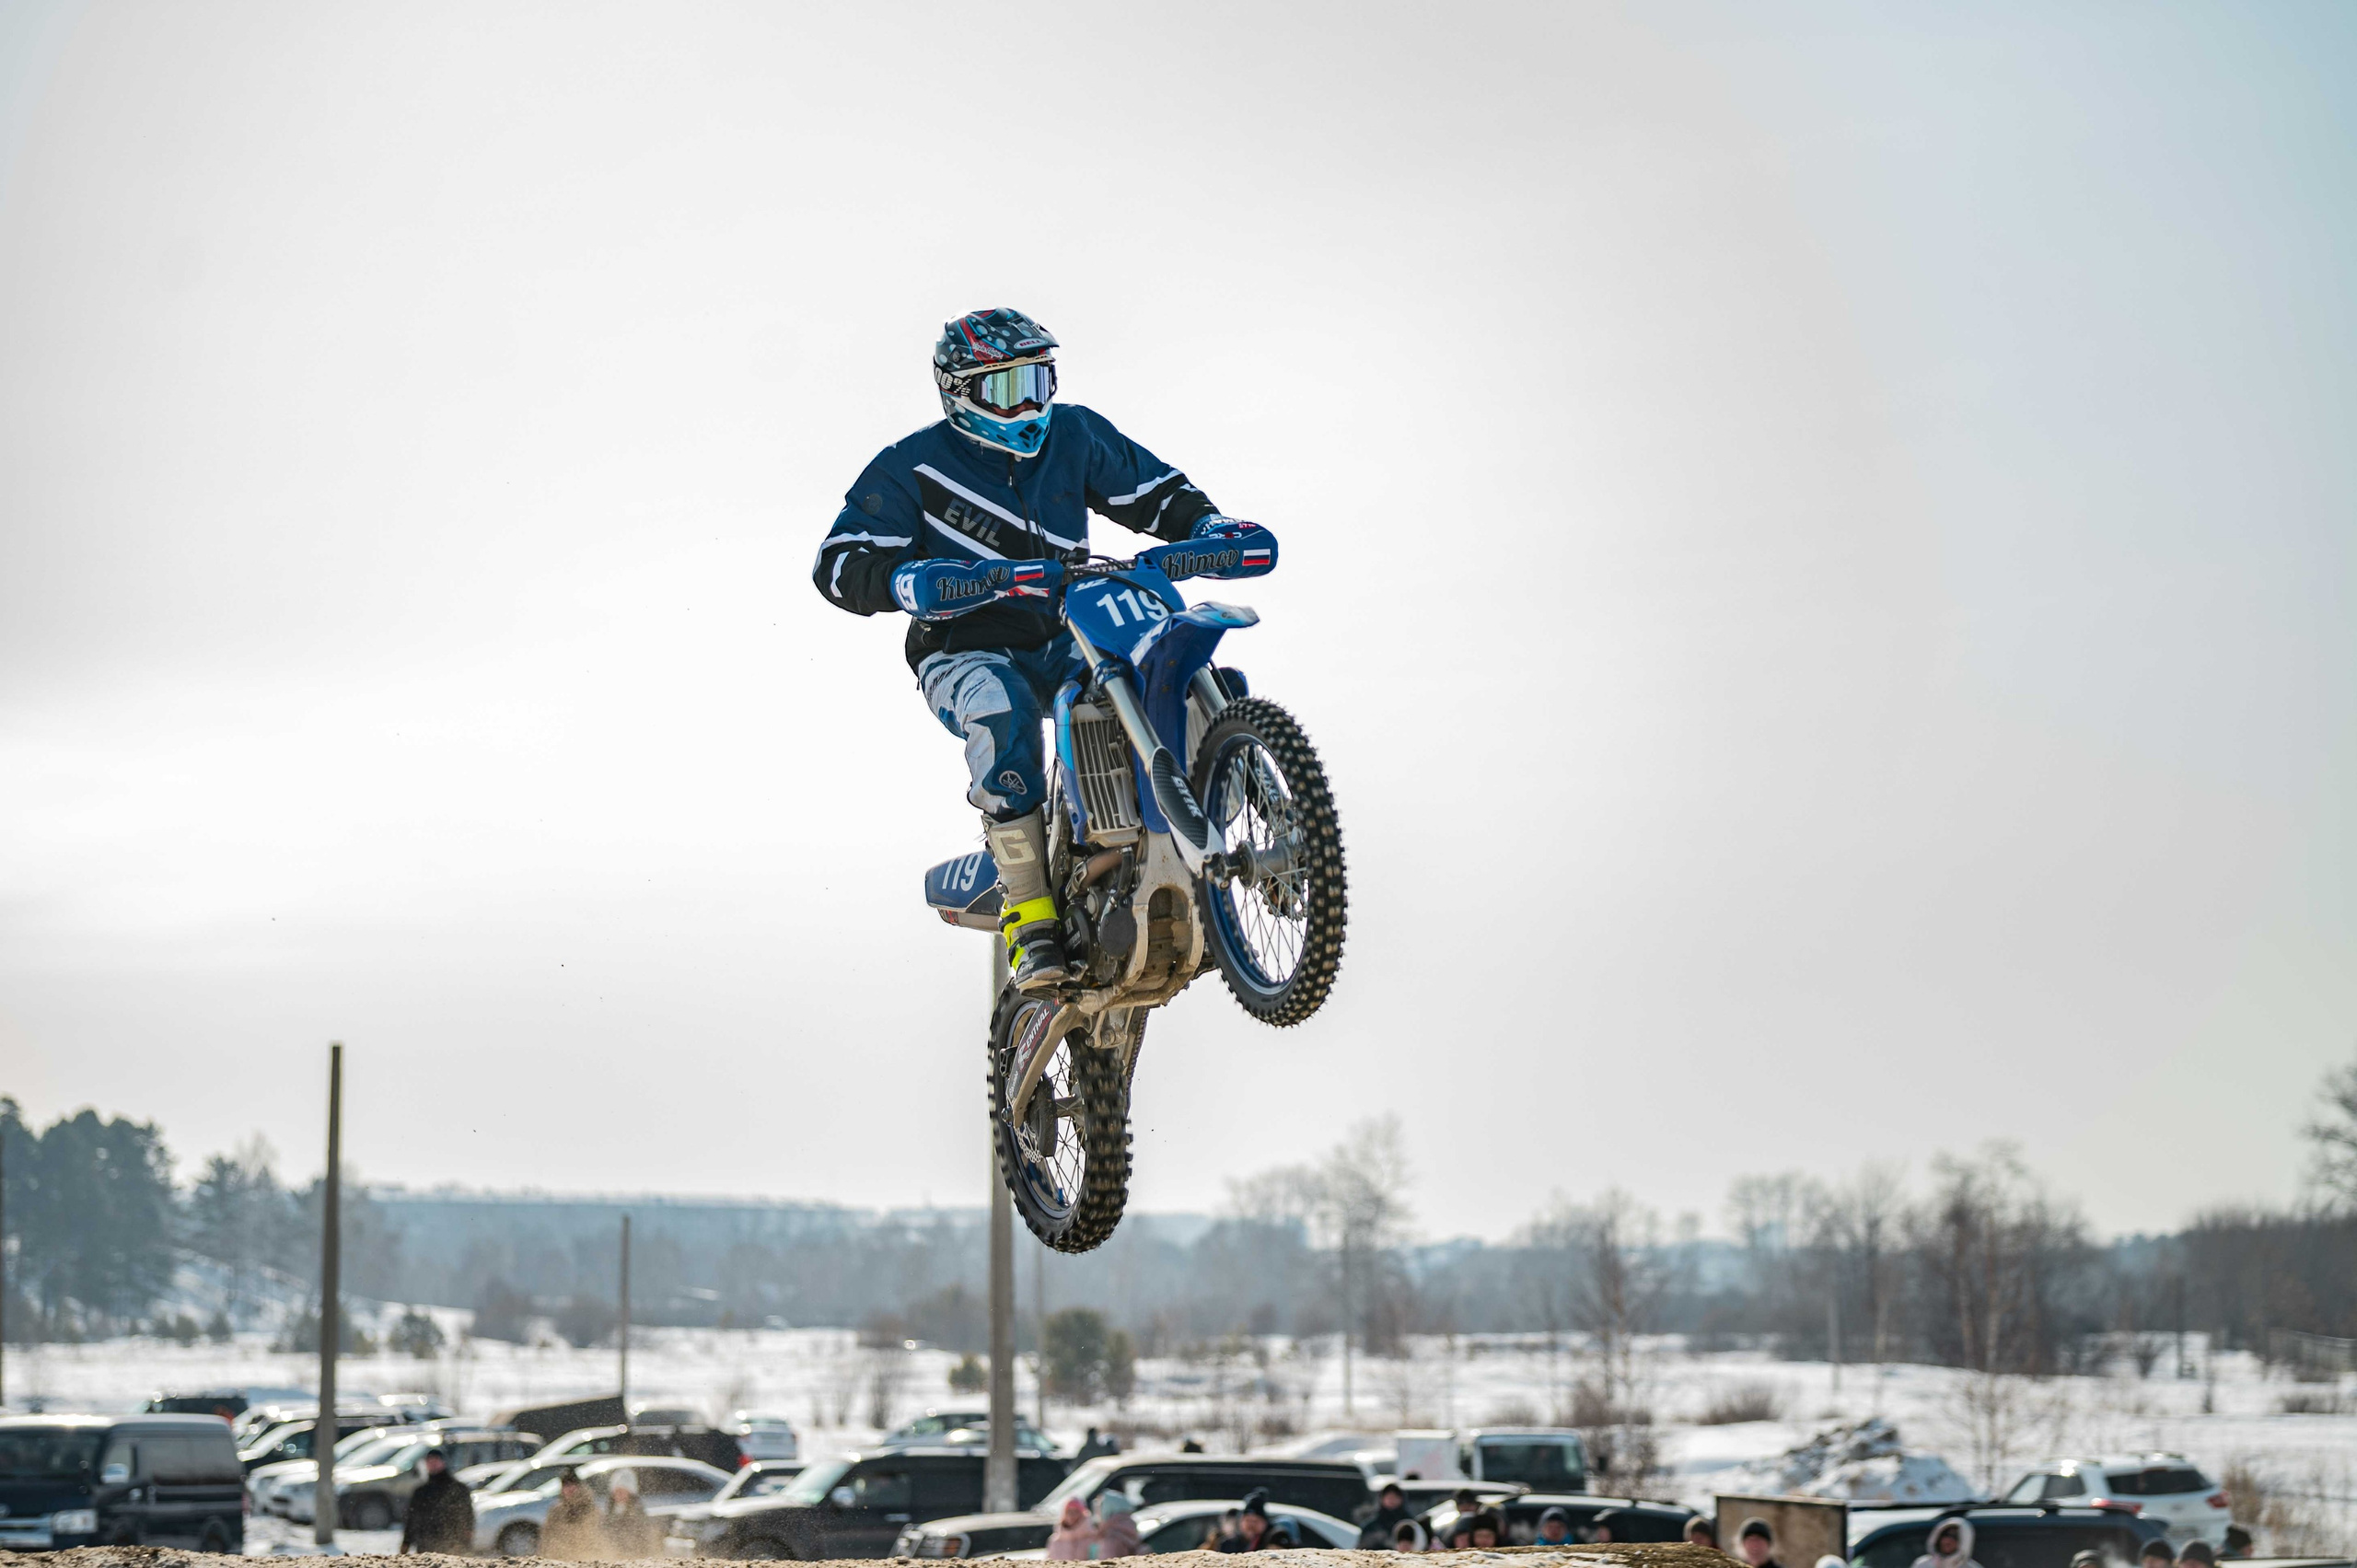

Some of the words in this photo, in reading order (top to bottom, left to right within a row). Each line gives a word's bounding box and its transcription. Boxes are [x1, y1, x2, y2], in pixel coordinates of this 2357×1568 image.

[935, 366, 971, 396] 00%
[944, 498, 1002, 547] EVIL
[1162, 550, 1239, 579] Klimov
[1097, 589, 1169, 627] 119
[1172, 775, 1203, 818] GYTR
[942, 852, 983, 891] 119
[1018, 1008, 1050, 1070] RENTHAL
